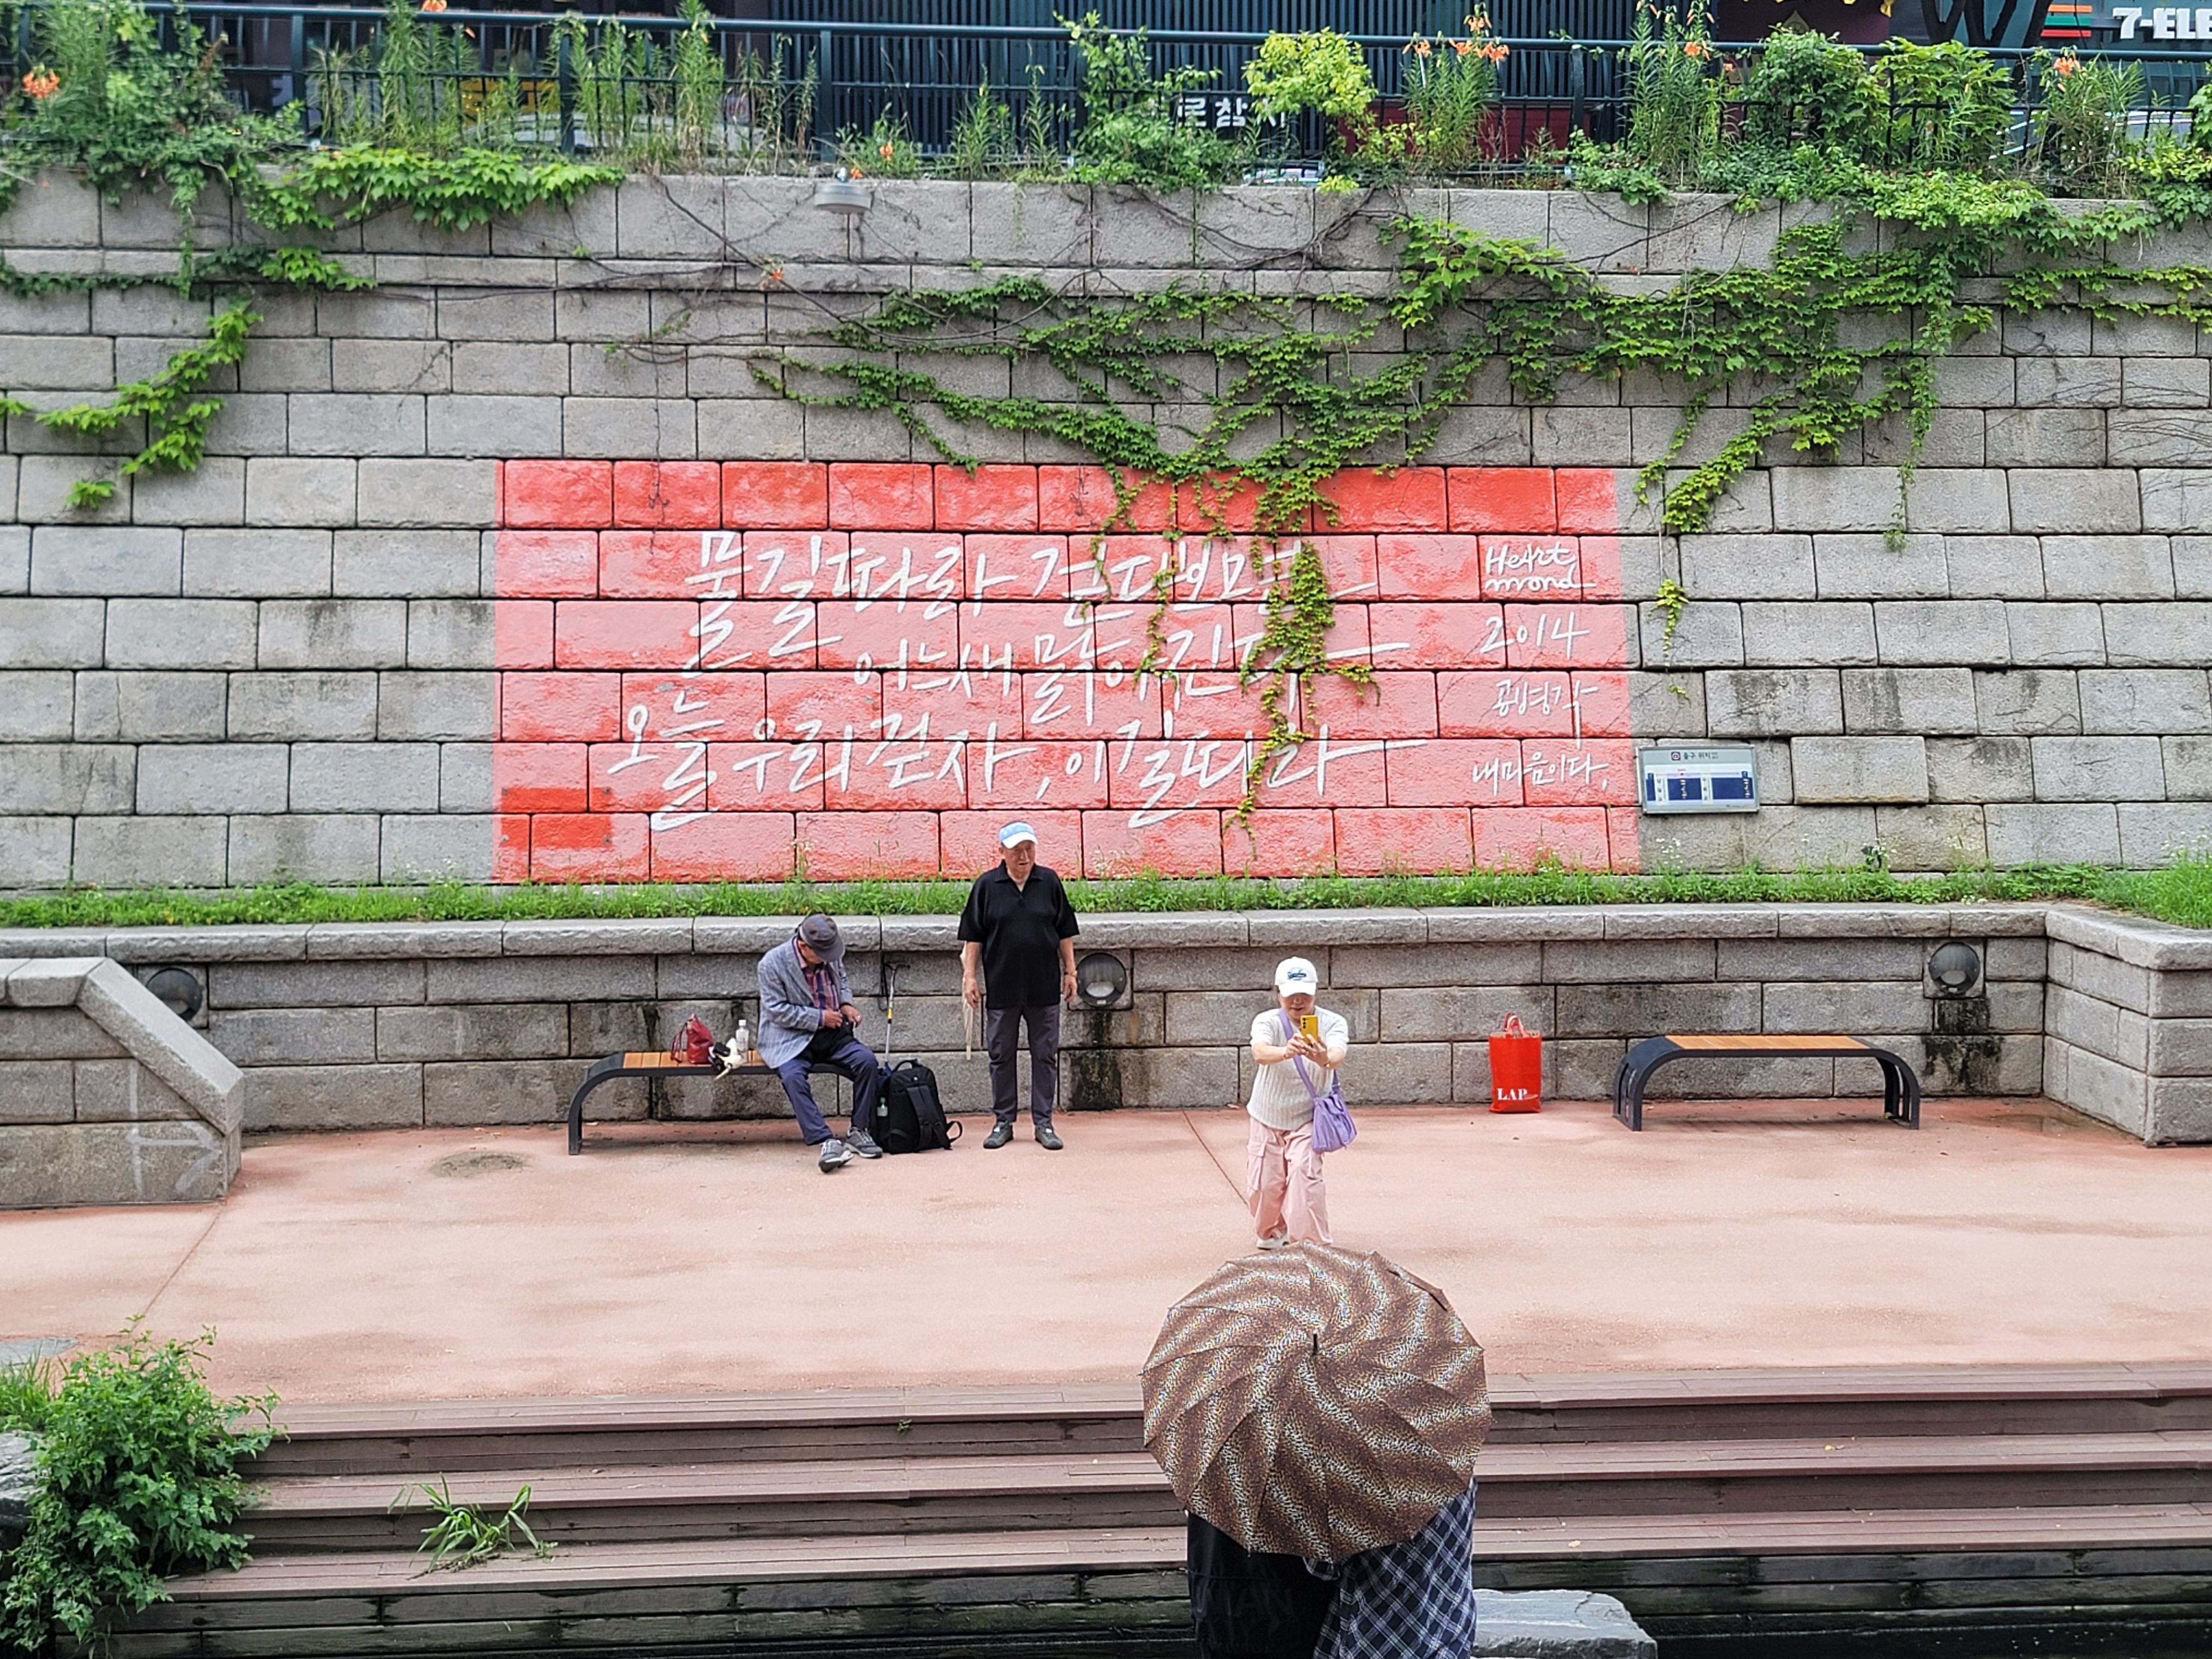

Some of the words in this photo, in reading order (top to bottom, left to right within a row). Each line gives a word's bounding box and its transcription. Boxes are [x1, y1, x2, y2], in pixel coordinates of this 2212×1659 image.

[1480, 611, 1590, 658] 2014
[1493, 680, 1600, 749] 공병각
[1496, 1088, 1528, 1100] LAP
